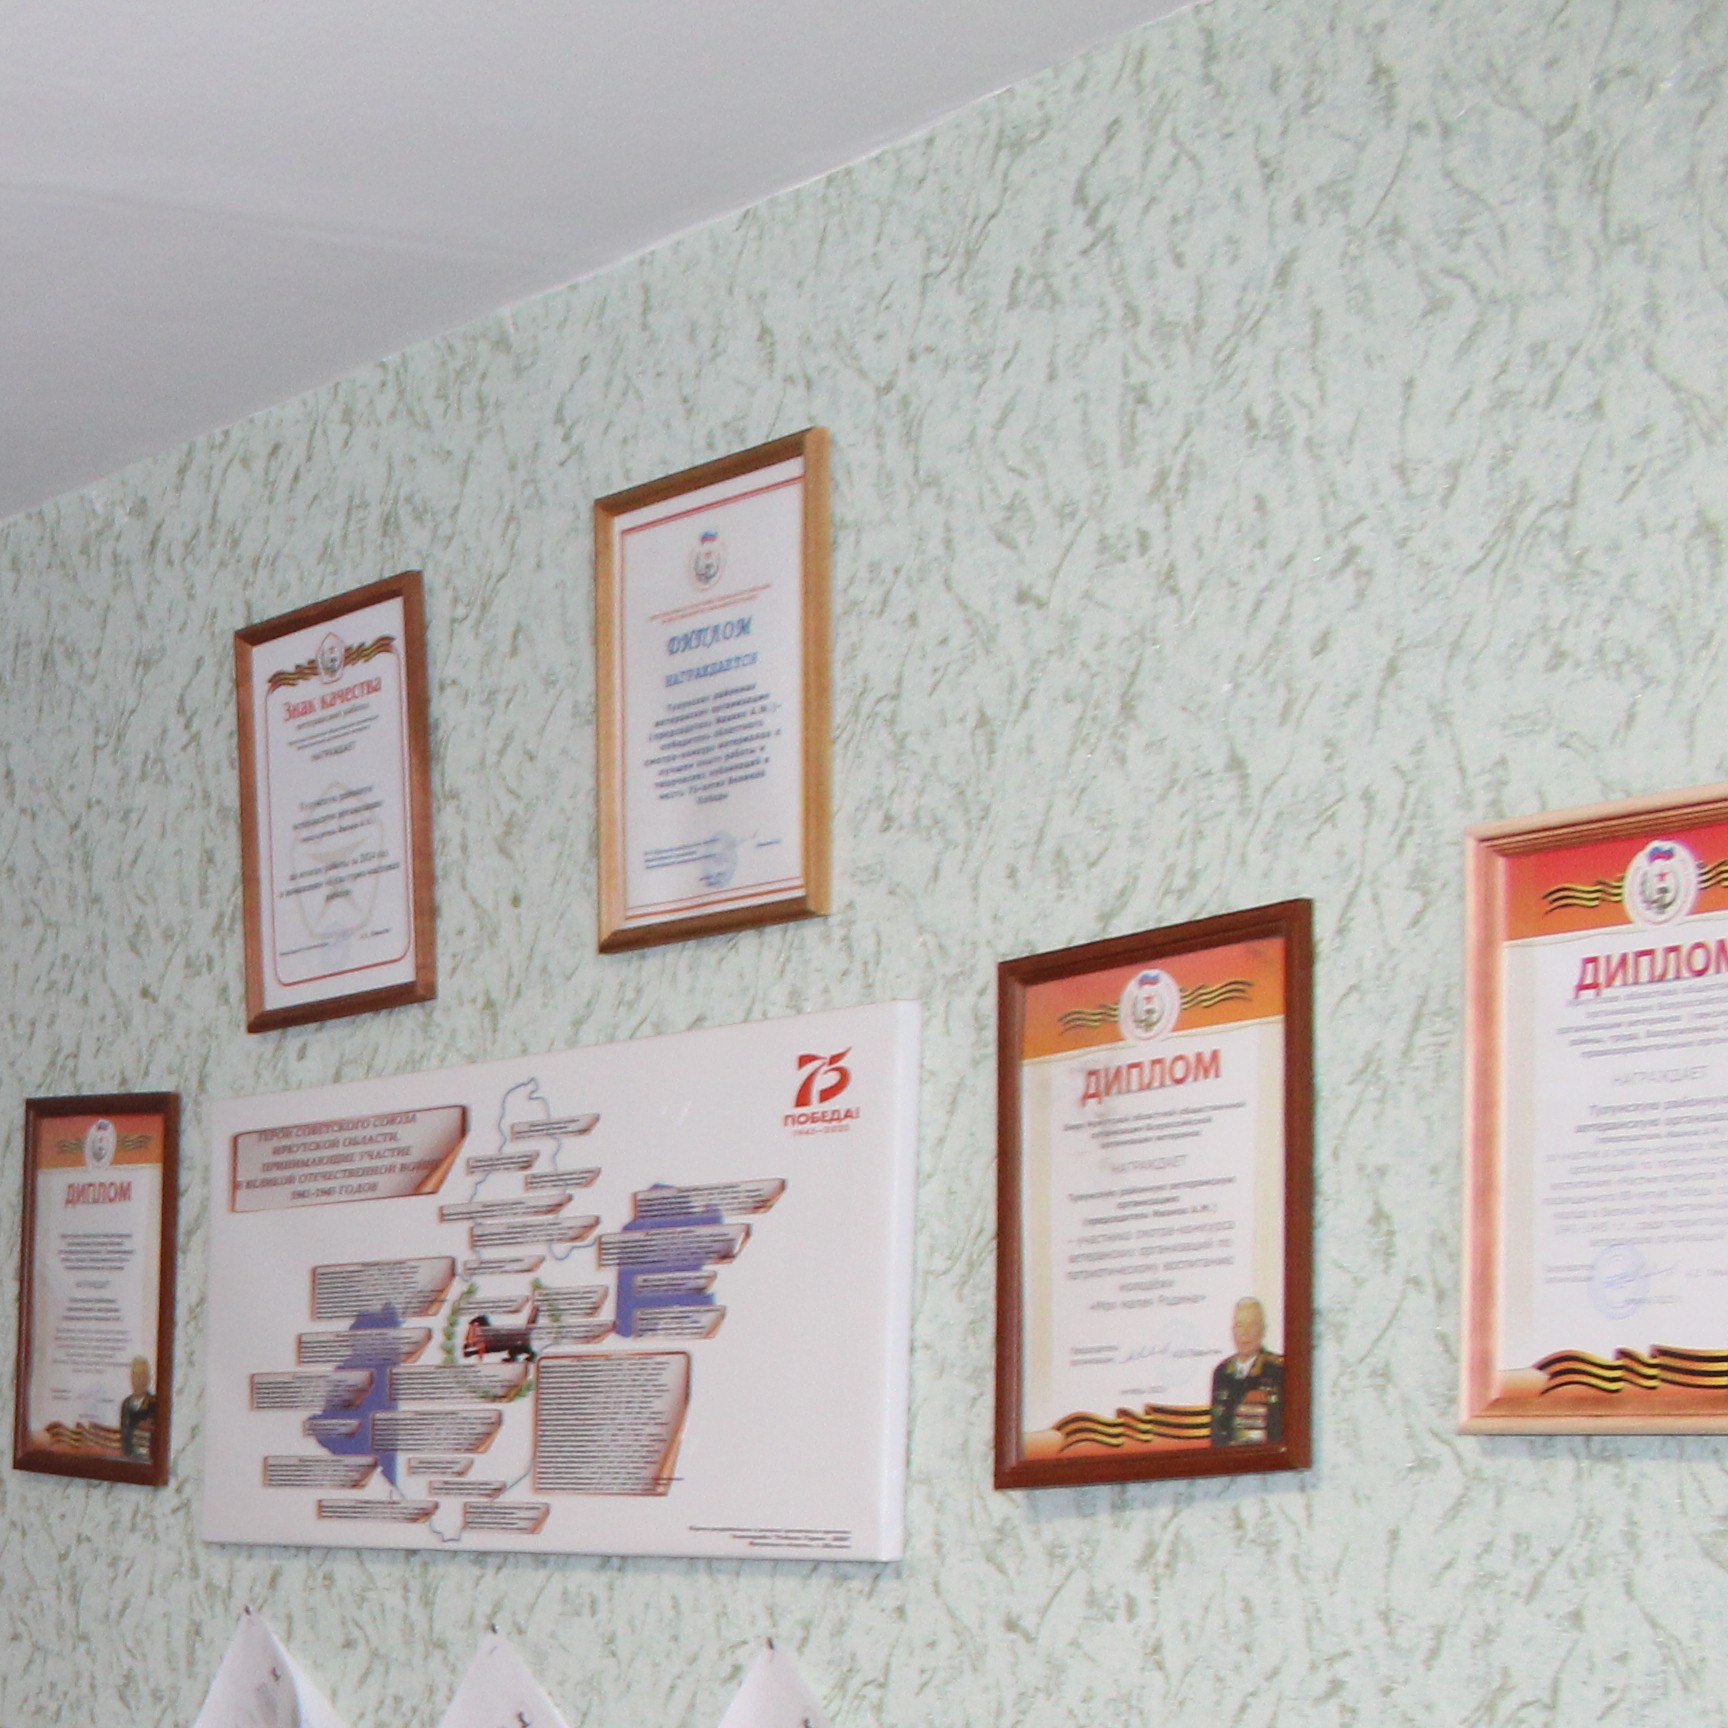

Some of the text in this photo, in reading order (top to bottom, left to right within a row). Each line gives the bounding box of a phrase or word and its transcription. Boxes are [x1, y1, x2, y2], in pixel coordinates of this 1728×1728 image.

[667, 615, 753, 656] ДИПЛОМ
[794, 1046, 852, 1108] 75
[1079, 1049, 1222, 1107] ДИПЛОМ
[783, 1106, 860, 1127] ПОБЕДА!
[64, 1180, 133, 1208] ДИПЛОМ
